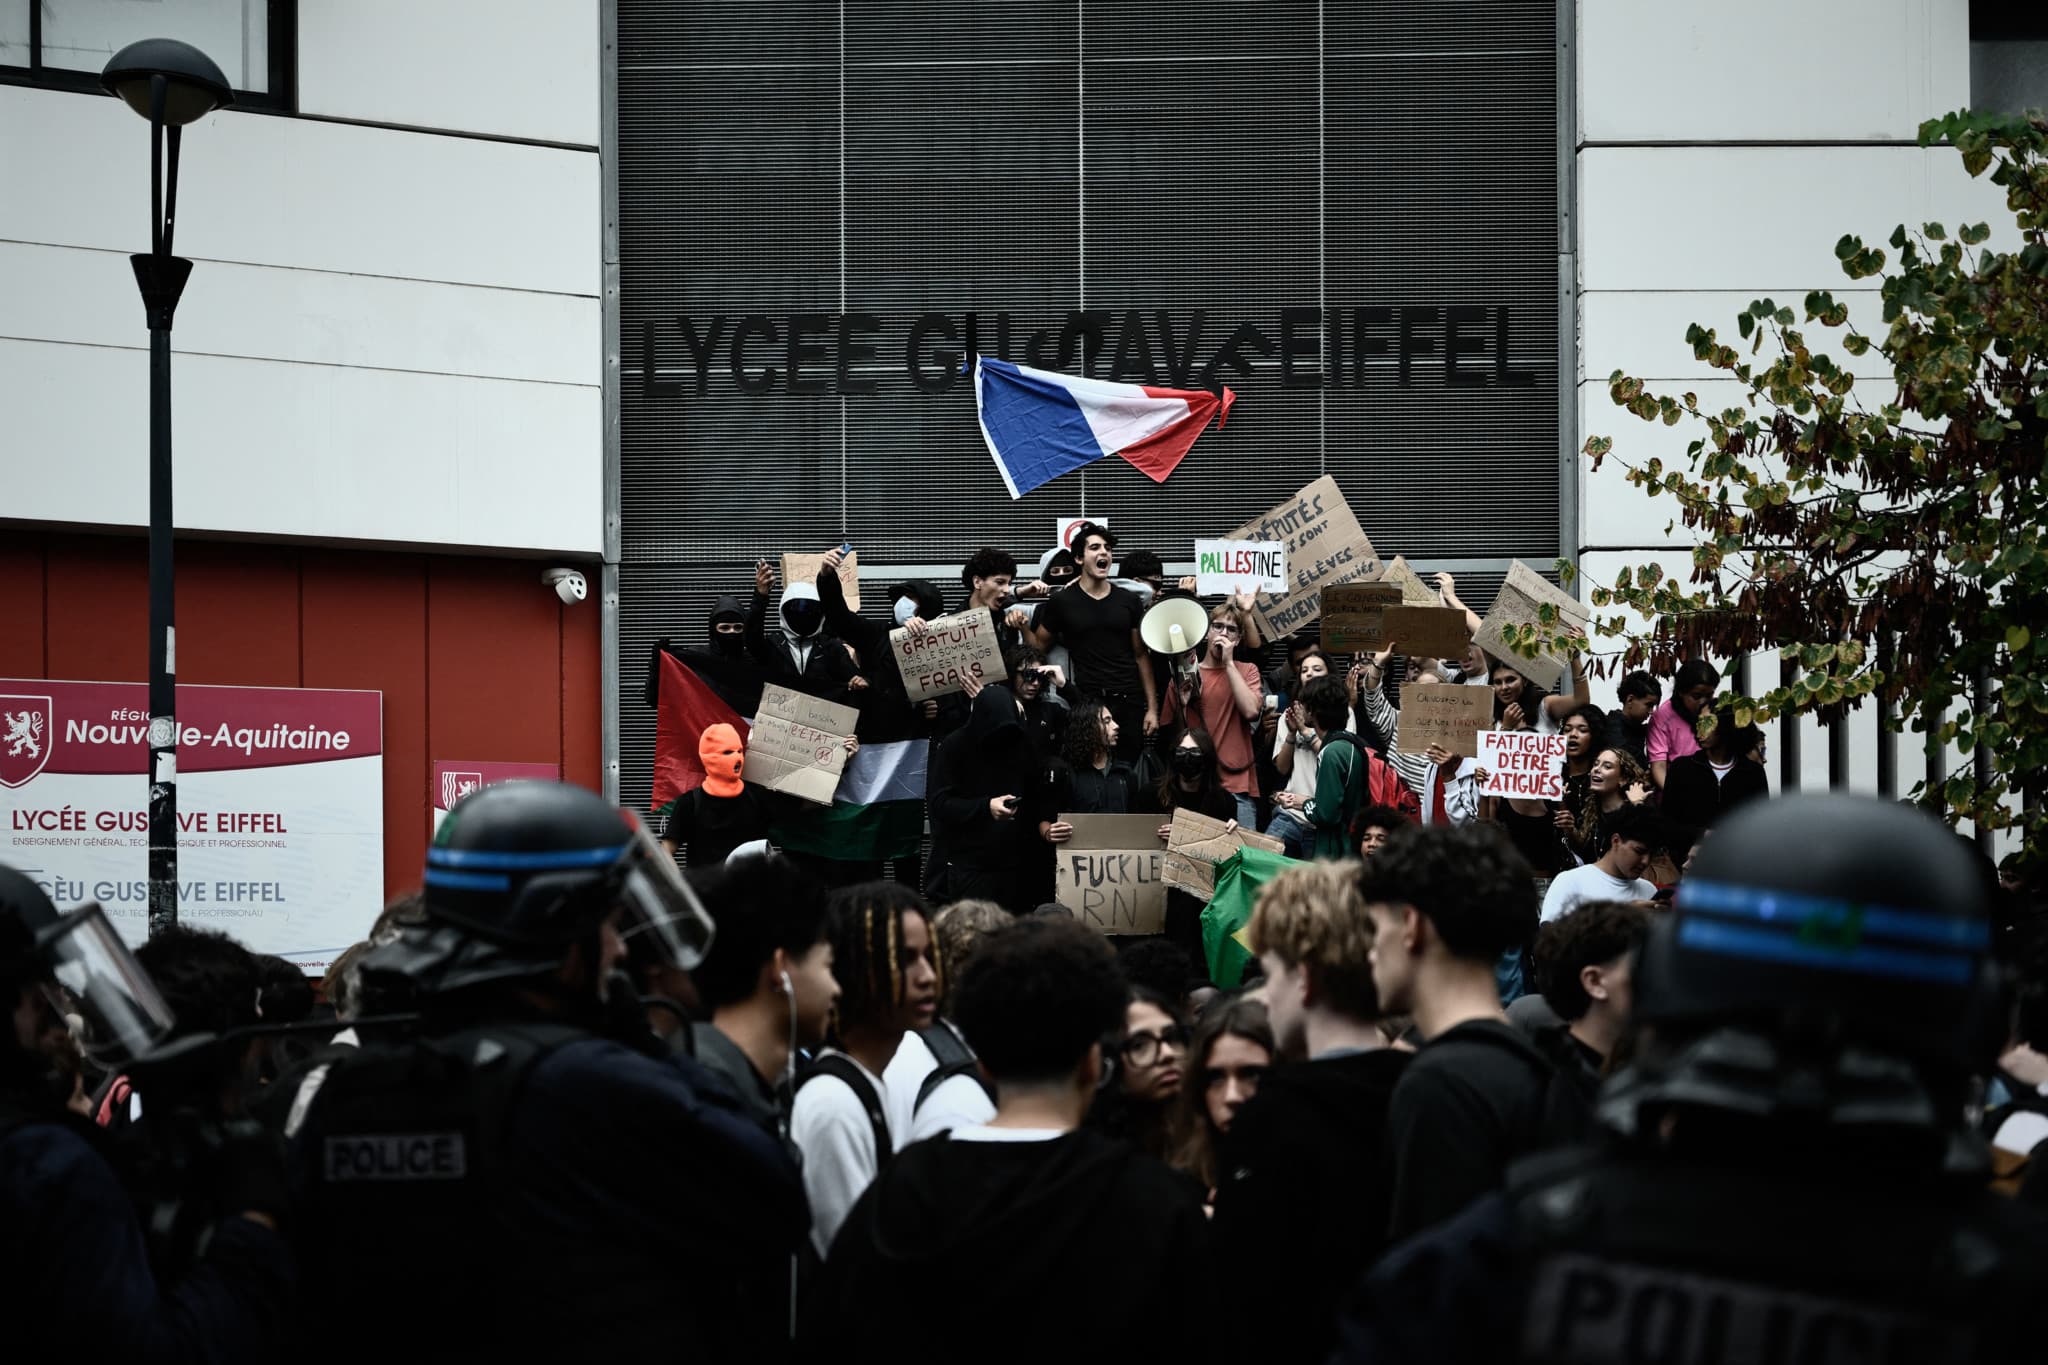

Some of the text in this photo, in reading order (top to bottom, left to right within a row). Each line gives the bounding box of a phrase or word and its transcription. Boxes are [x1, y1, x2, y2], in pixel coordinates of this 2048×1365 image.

[643, 314, 881, 397] LYCEE
[1280, 305, 1534, 388] EIFFEL
[1299, 520, 1328, 547] SONT
[1200, 550, 1282, 578] PALLESTINE
[926, 650, 937, 661] LE
[938, 656, 957, 669] EST
[971, 647, 992, 660] NOS
[919, 662, 984, 692] FRAIS
[110, 707, 149, 721] RÉGI
[65, 718, 351, 757] Nouvle-Aquitaine
[1486, 734, 1566, 757] FATIGUÉS
[1498, 751, 1549, 771] D'ÊTRE
[13, 804, 287, 833] LYCÉE GUSVE EIFFEL
[13, 837, 80, 847] ENSEIGNEMENT
[83, 836, 127, 848] GÉNÉRAL,
[208, 840, 217, 848] ET
[219, 840, 287, 849] PROFESSIONNEL
[1072, 855, 1161, 888] FUCK LE
[93, 881, 206, 902] GUSVE
[215, 882, 286, 902] EIFFEL
[1084, 888, 1137, 928] RN
[333, 1137, 450, 1175] POLICE
